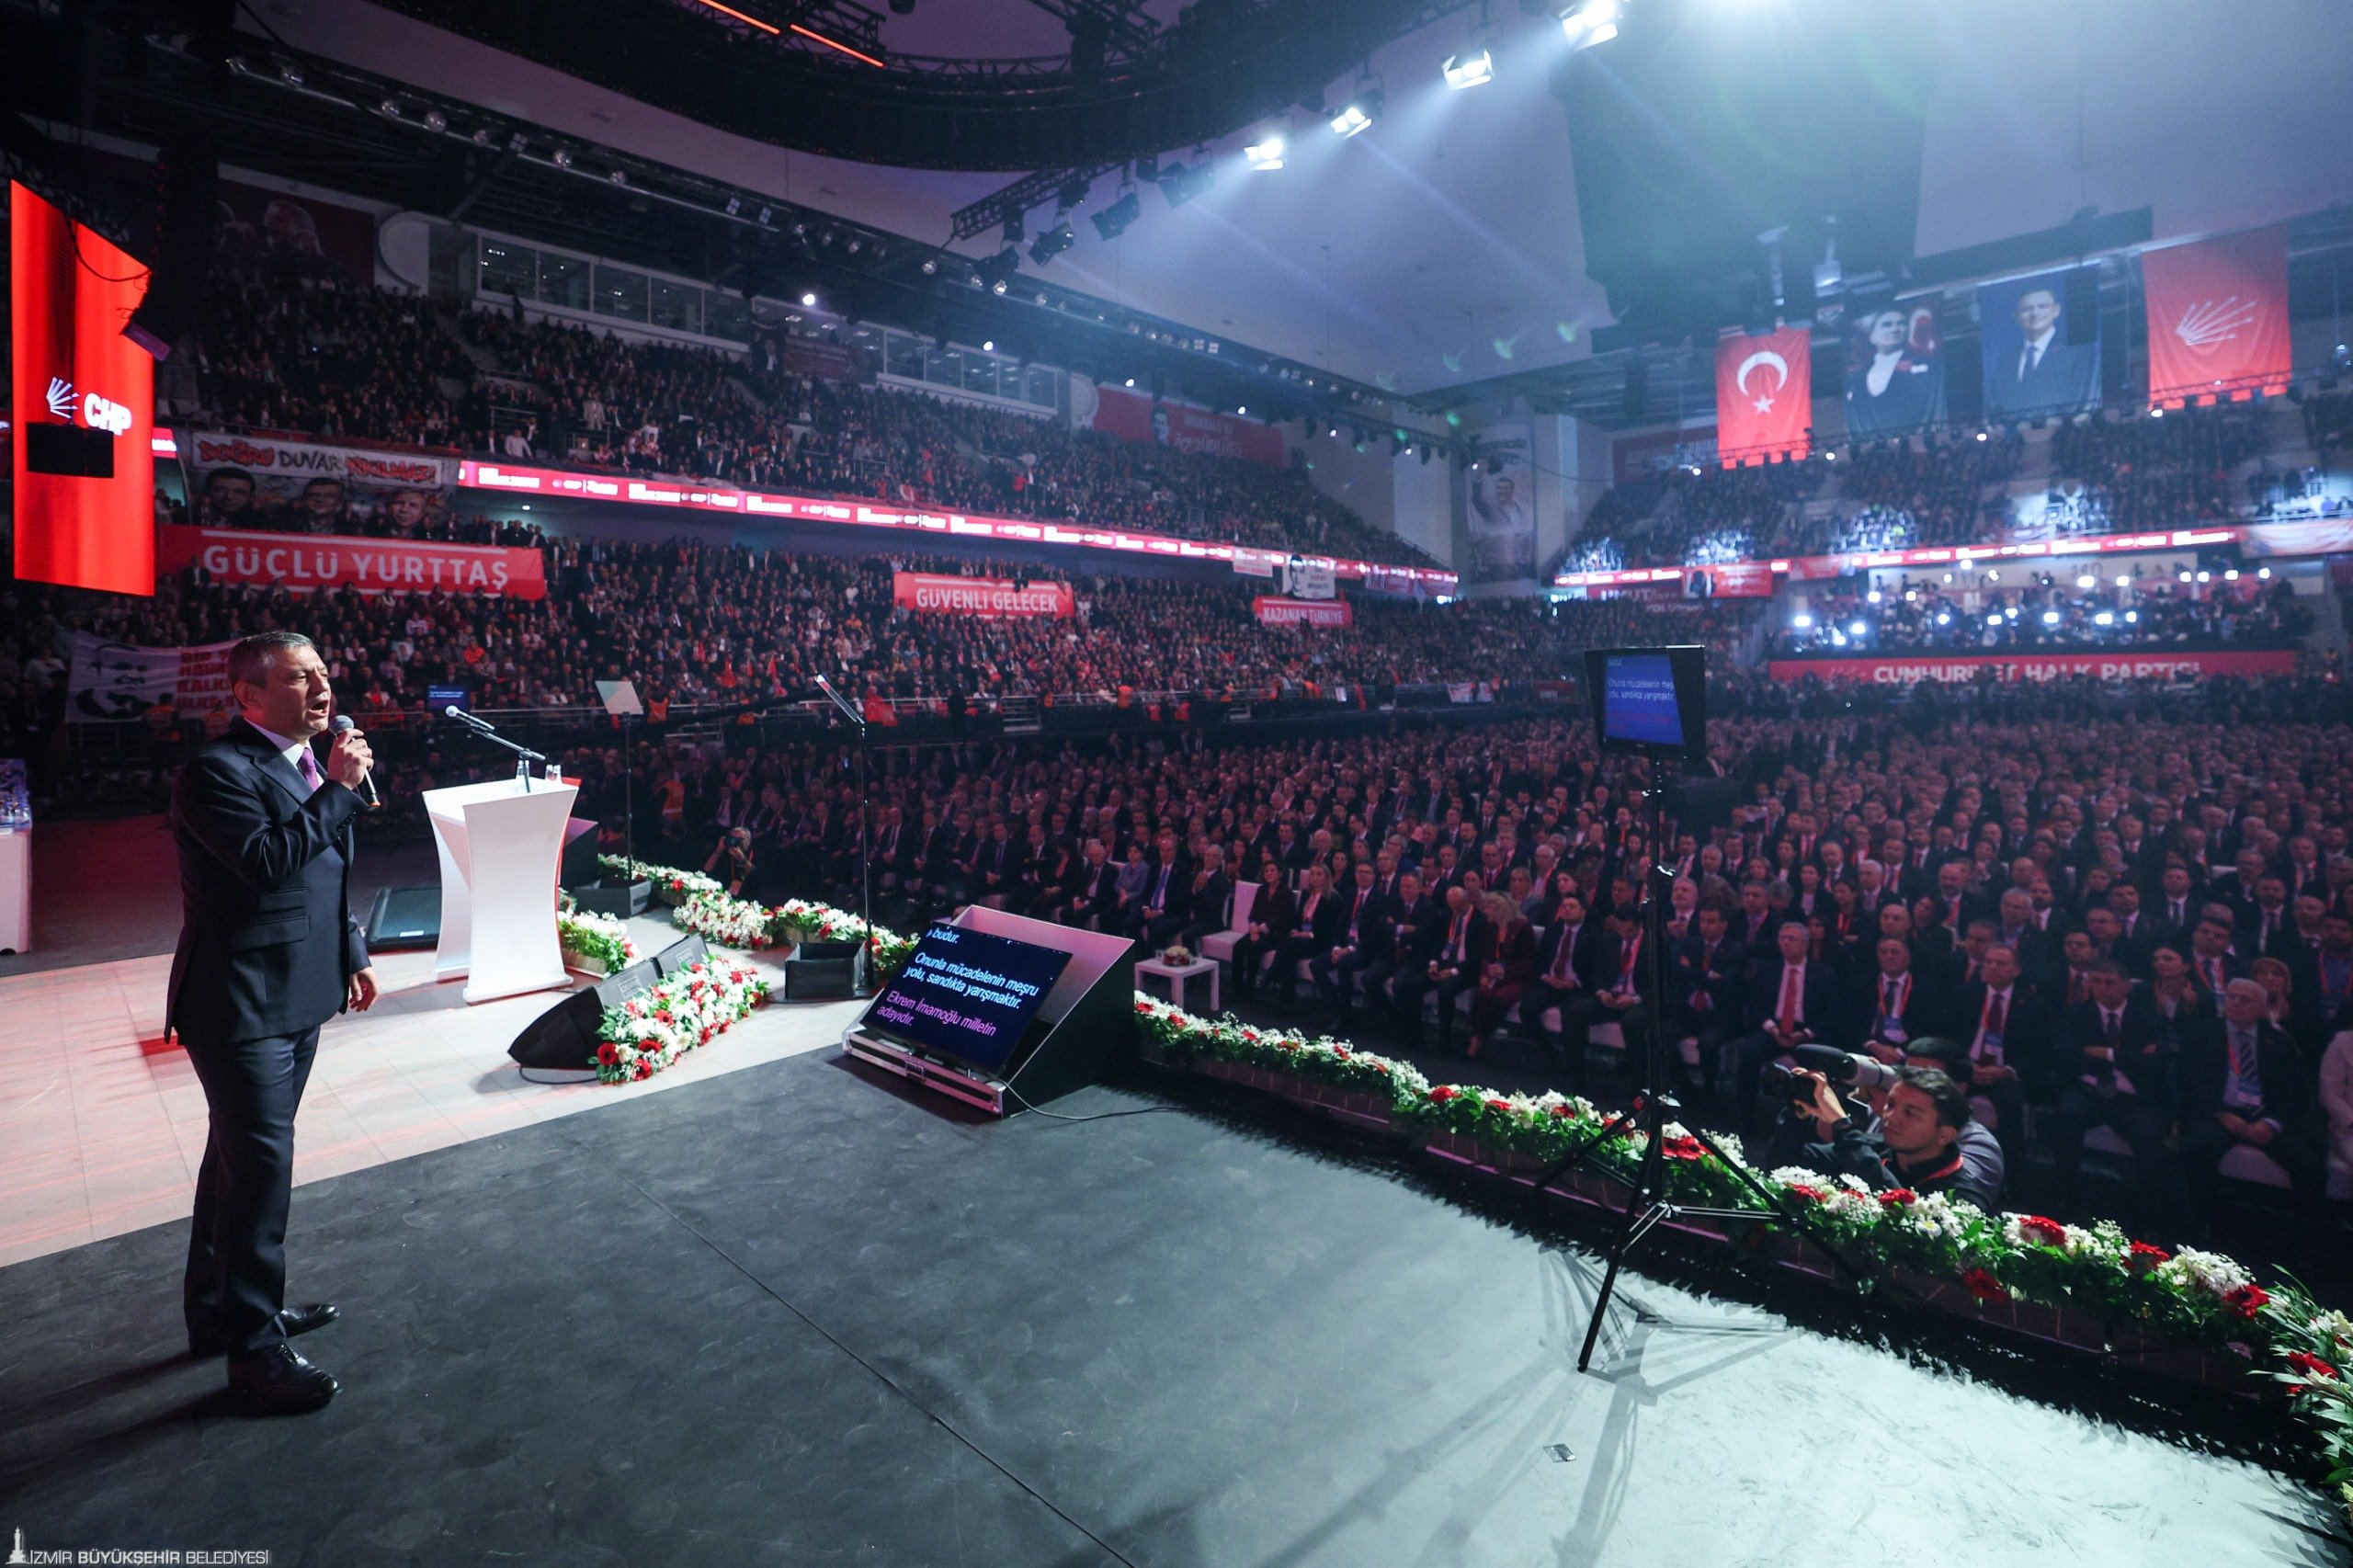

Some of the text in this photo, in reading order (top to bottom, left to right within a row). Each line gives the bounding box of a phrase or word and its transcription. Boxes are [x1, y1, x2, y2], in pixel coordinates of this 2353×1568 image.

[84, 392, 131, 436] CHP
[278, 449, 340, 472] DUVAR
[203, 545, 509, 589] GÜÇLÜ YURTTAŞ
[916, 588, 1057, 612] GÜVENLİ GELECEK
[1264, 607, 1307, 622] KAZANAN
[932, 927, 960, 944] budur.
[903, 966, 1022, 1009] yolu, sandıkta yarışmaktır.
[915, 952, 1040, 996] Onunla mücadelenin meşru
[877, 1006, 915, 1026] adayıdır.
[886, 990, 996, 1037] Ekrem İmamoğlu milletin
